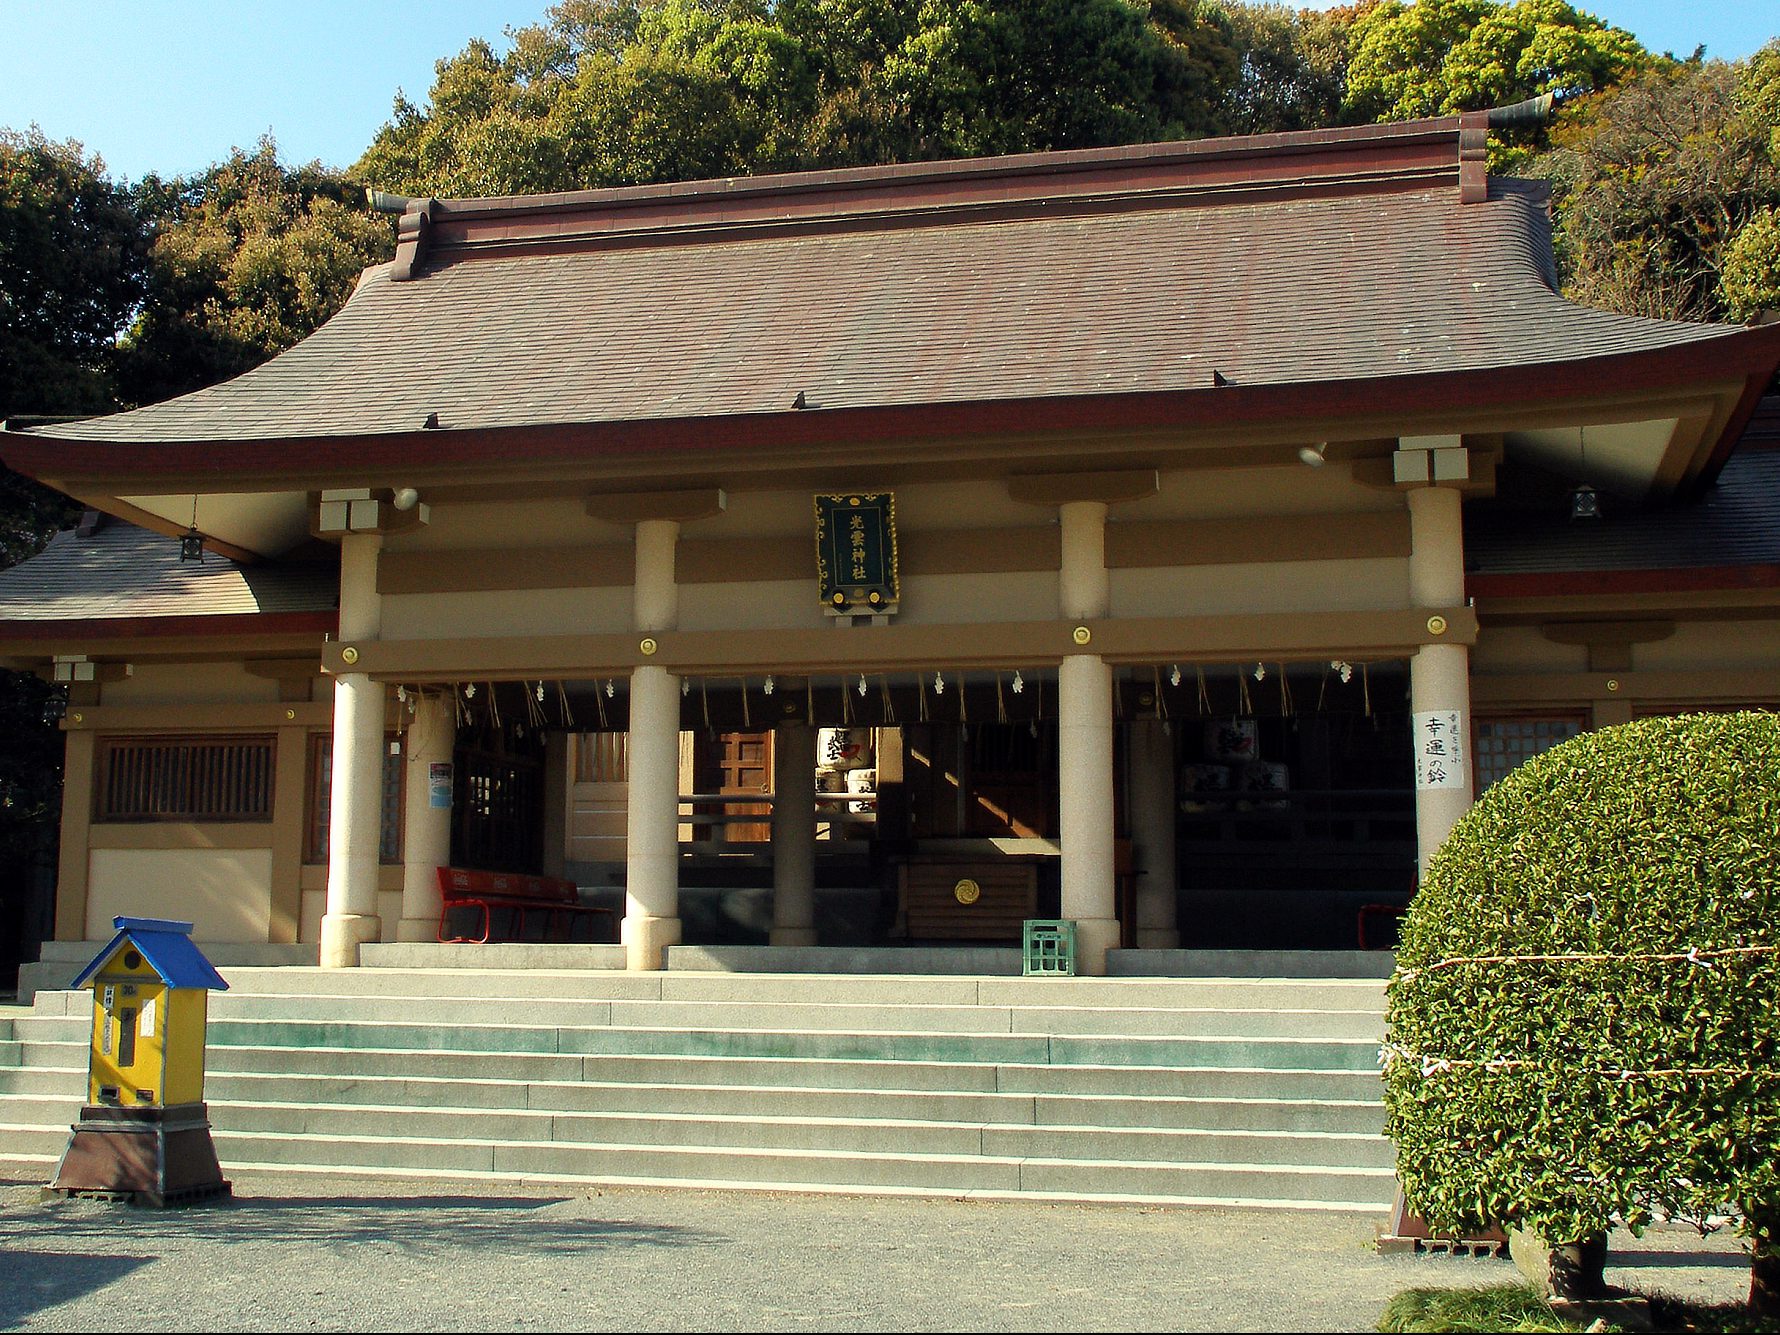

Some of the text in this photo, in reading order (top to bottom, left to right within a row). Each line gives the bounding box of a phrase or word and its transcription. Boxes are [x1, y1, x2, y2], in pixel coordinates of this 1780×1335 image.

[849, 514, 867, 580] 光雲神社
[1425, 716, 1447, 784] 幸運の鈴
